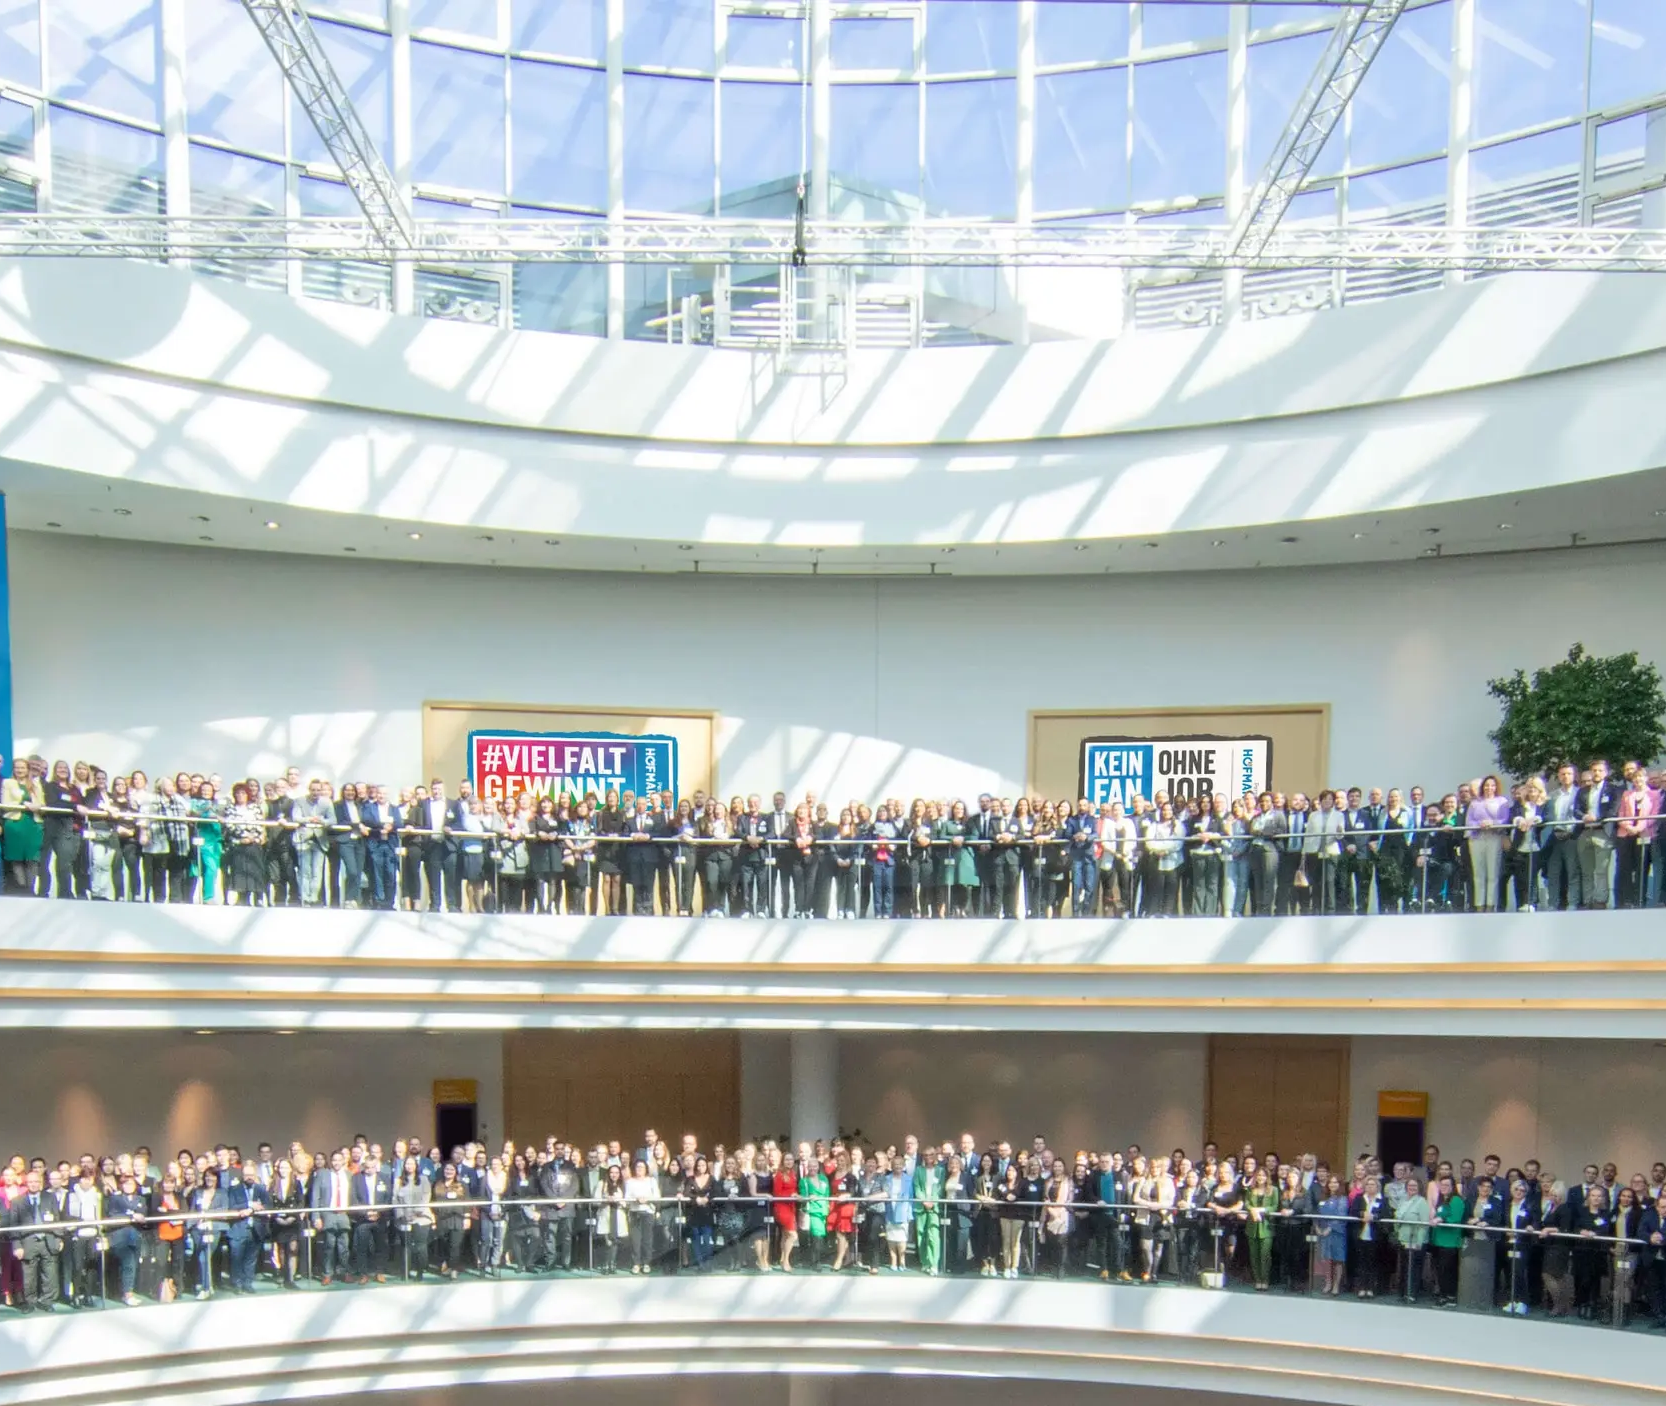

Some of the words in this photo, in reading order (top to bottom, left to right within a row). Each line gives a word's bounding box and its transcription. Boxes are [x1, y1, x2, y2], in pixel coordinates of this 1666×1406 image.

[481, 744, 627, 776] #VIELFALT
[1094, 751, 1144, 777] KEIN
[1158, 749, 1217, 776] OHNE
[1094, 778, 1143, 809] FAN
